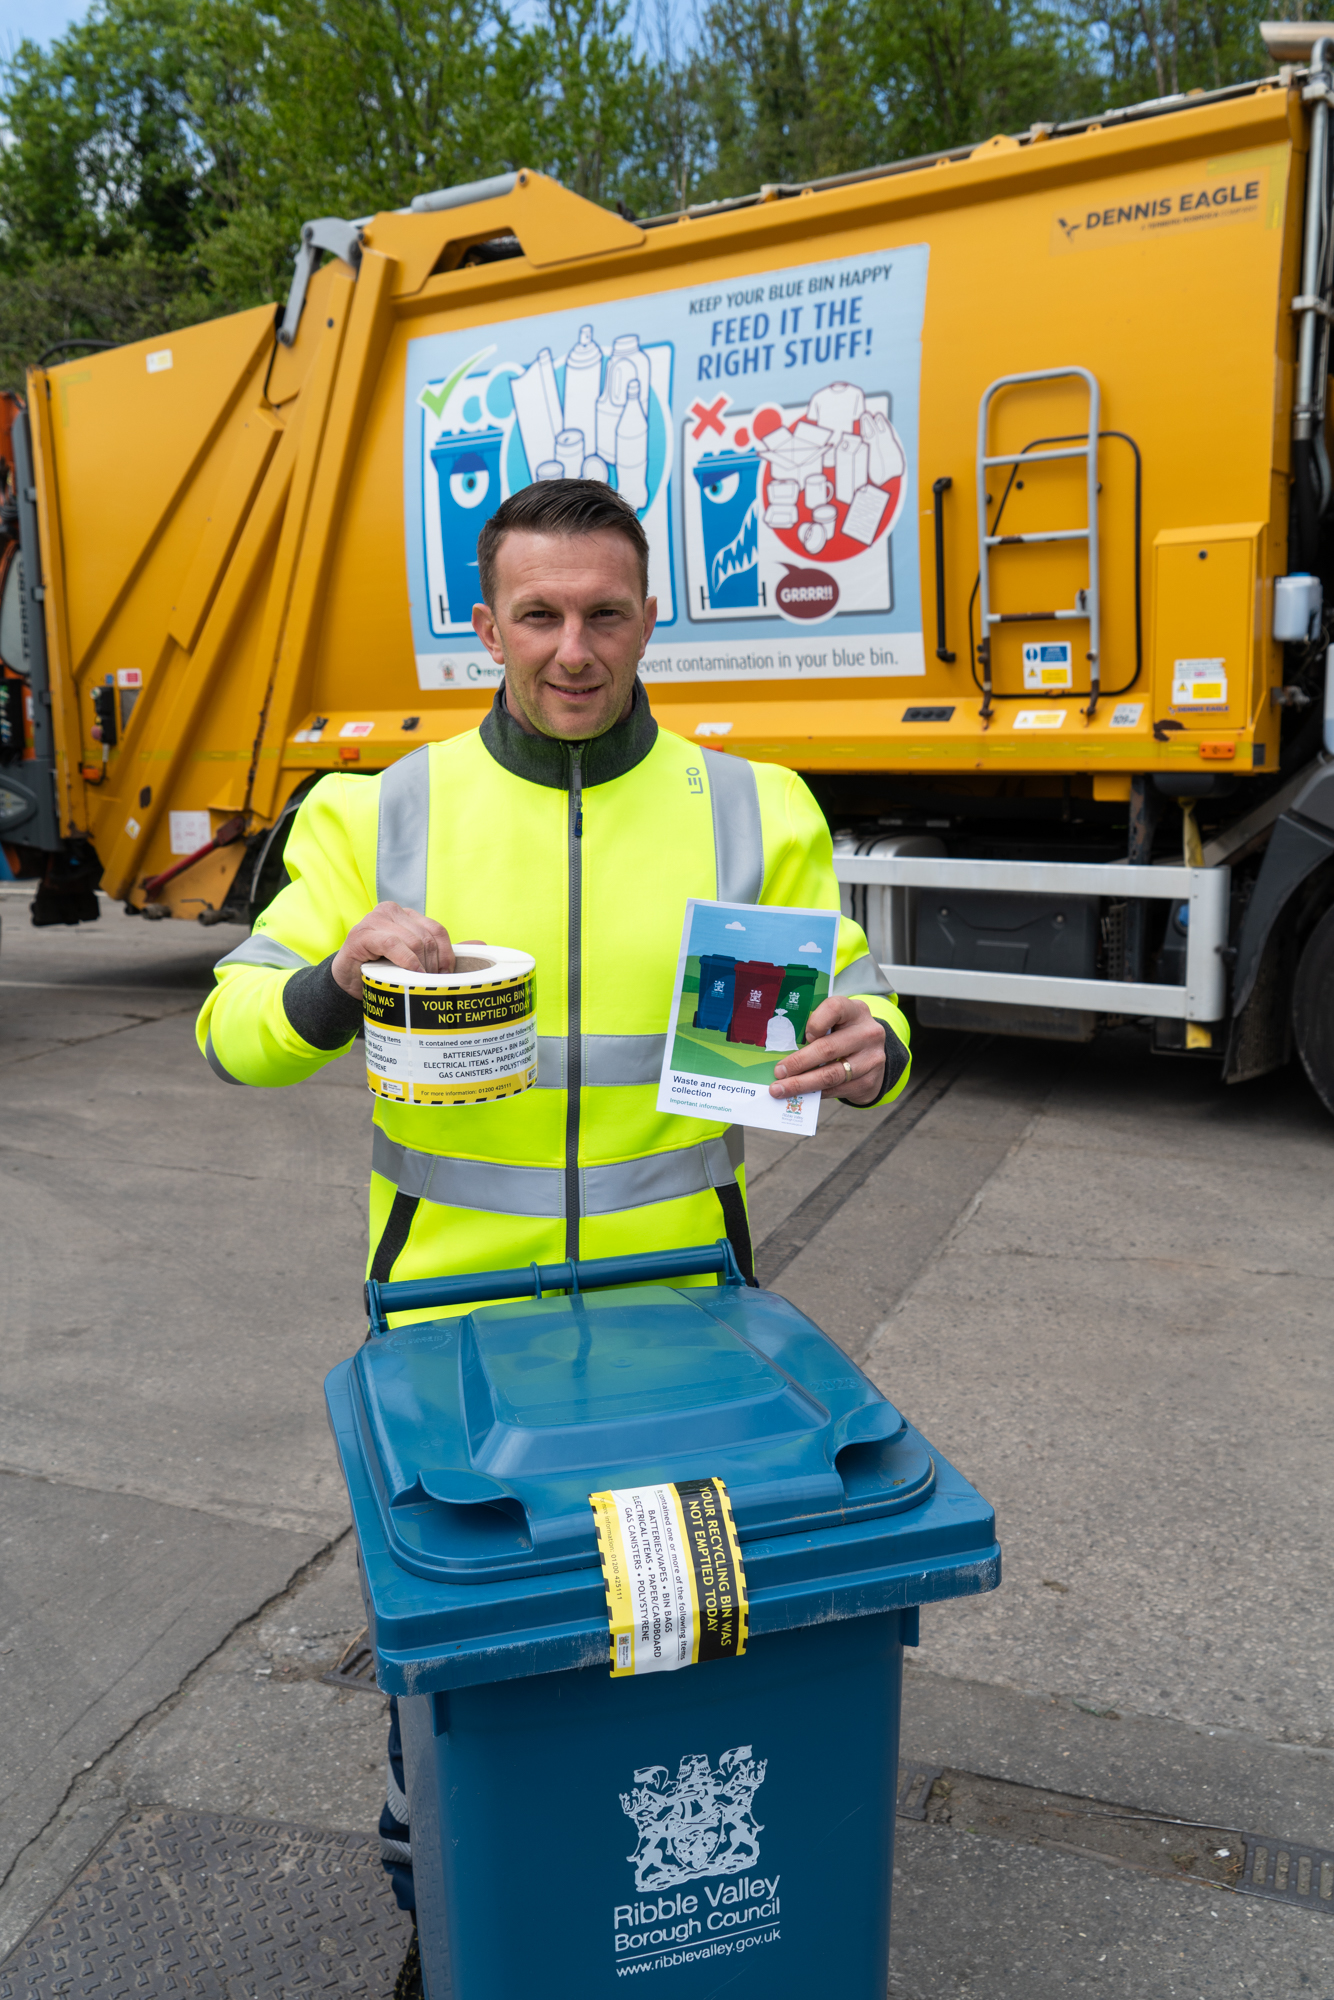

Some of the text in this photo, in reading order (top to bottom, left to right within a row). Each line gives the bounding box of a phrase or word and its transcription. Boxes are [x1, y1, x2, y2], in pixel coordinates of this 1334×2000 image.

[1086, 180, 1260, 230] DENNIS EAGLE
[689, 264, 893, 316] KEEP YOUR BLUE BIN HAPPY
[711, 296, 863, 347] FEED IT THE
[697, 327, 873, 381] RIGHT STUFF!
[780, 585, 833, 603] GRRRR!!
[636, 645, 899, 674] event contamination in your blue bin.
[686, 767, 703, 795] LEO
[367, 1002, 384, 1017] TODAY
[368, 991, 376, 1003] BIN
[378, 995, 395, 1008] WAS
[422, 1001, 453, 1011] YOUR
[459, 994, 512, 1010] RECYCLING
[513, 988, 525, 1001] BIN
[438, 999, 531, 1024] NOT EMPTIED TODAY
[506, 1031, 515, 1039] the
[443, 1046, 503, 1059] BATTERIES/VAPES
[519, 1037, 529, 1048] BAGS
[423, 1061, 466, 1069] ELECTRICAL
[468, 1059, 489, 1067] ITEMS
[438, 1054, 532, 1079] GAS CANISTERS POLYSTYRENE
[495, 1083, 512, 1091] 425111
[671, 1086, 712, 1098] collection
[673, 1075, 756, 1097] Waste and recycling
[669, 1098, 732, 1113] Important information
[658, 1494, 672, 1526] contained
[666, 1528, 674, 1542] one
[669, 1543, 676, 1552] or
[605, 1515, 615, 1553] information:
[610, 1554, 619, 1574] 01200
[615, 1575, 623, 1600] 425111
[671, 1553, 680, 1574] more
[688, 1500, 718, 1632] NOT EMPTIED TODAY
[699, 1486, 732, 1647] YOUR RECYCLING BIN WAS
[625, 1507, 650, 1642] GAS CANISTERS POLYSTYRENE
[632, 1495, 662, 1658] ELECTRICAL ITEMS PAPER/CARDBOARD
[648, 1509, 673, 1633] BATTERIES/VAPES BIN BAGS
[675, 1575, 684, 1584] of
[677, 1588, 685, 1600] the
[679, 1602, 687, 1639] following
[680, 1640, 688, 1661] items
[614, 1874, 781, 1930] Ribble Valley
[615, 1896, 781, 1952] Borough Council
[616, 1928, 781, 1977] www.ribblevalley.gov.uk
